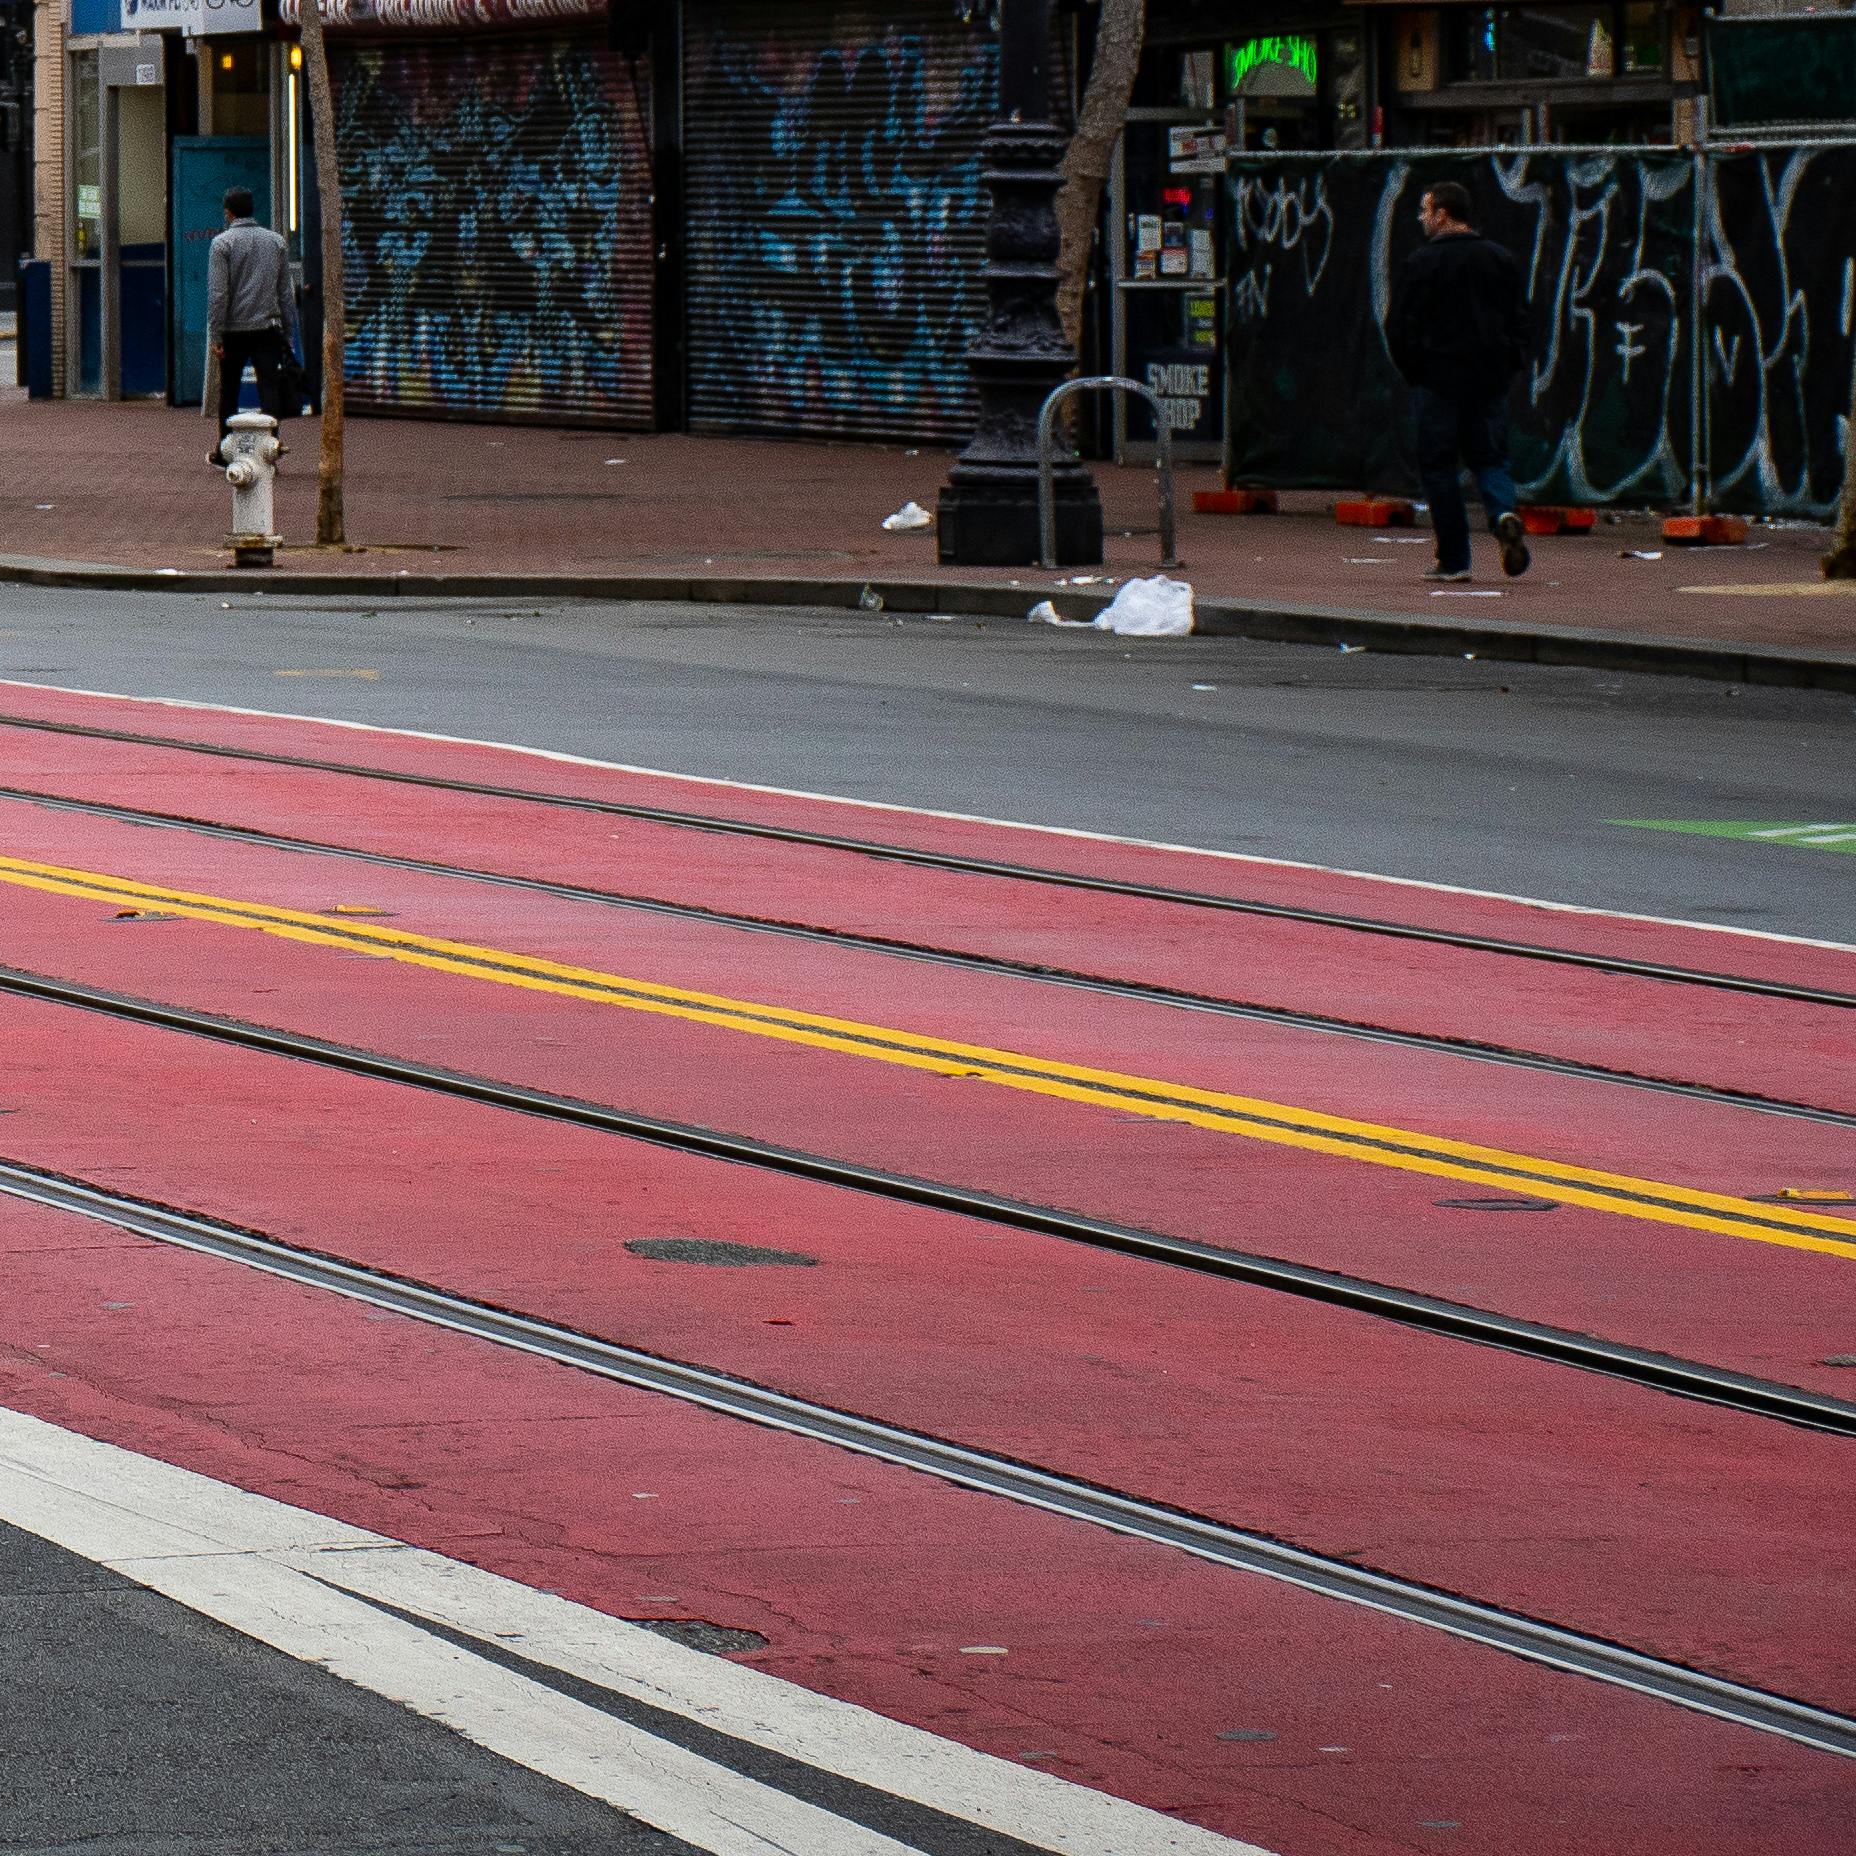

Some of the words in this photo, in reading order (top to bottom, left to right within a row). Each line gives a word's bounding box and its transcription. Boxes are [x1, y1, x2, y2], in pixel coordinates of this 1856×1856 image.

[1288, 34, 1317, 86] SHO
[1146, 363, 1209, 397] SMOKE
[1161, 397, 1201, 430] HOP
